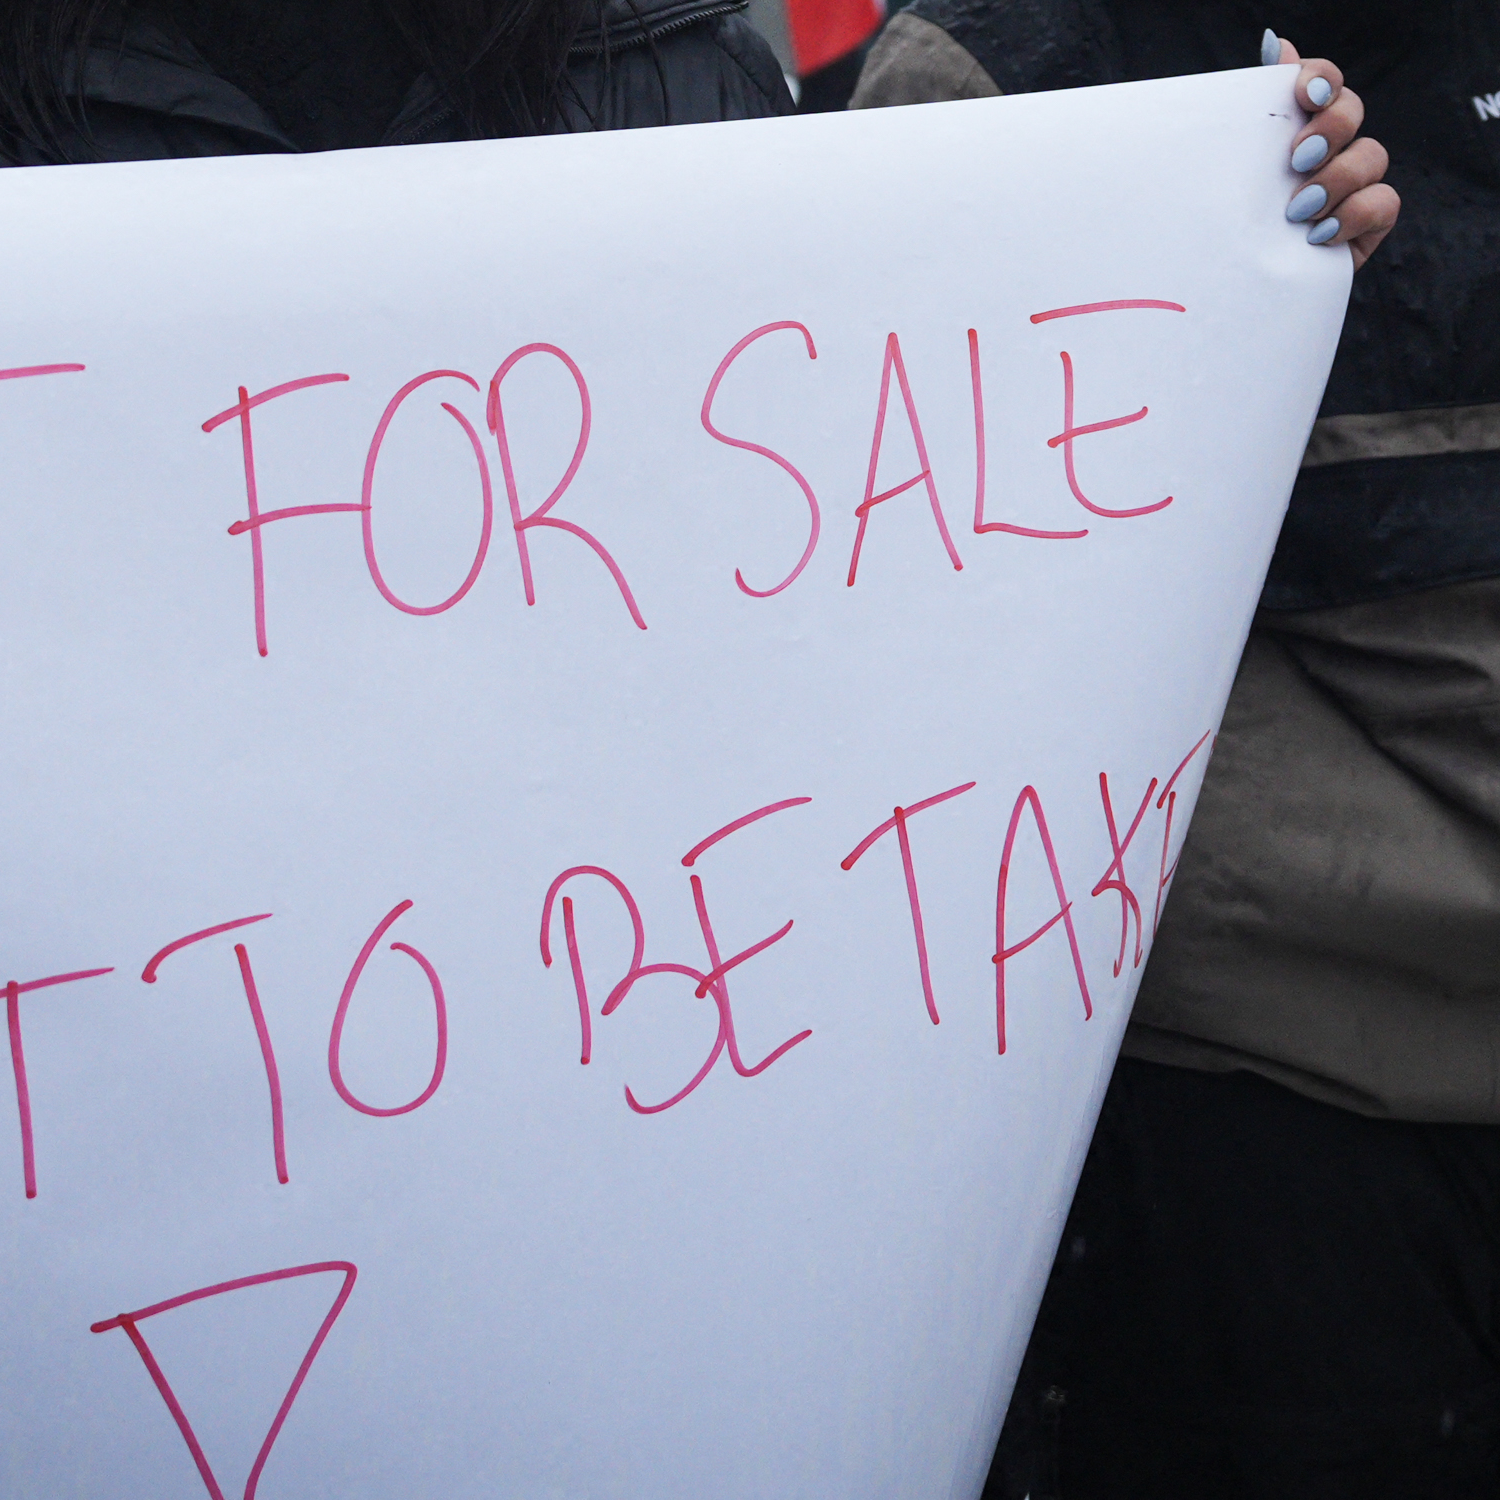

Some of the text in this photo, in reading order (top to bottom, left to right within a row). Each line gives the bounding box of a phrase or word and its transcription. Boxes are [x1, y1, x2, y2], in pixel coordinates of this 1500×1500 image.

[202, 342, 648, 657] FOR
[700, 299, 1187, 598] SALE
[140, 899, 448, 1186] TO
[540, 796, 813, 1115] BE
